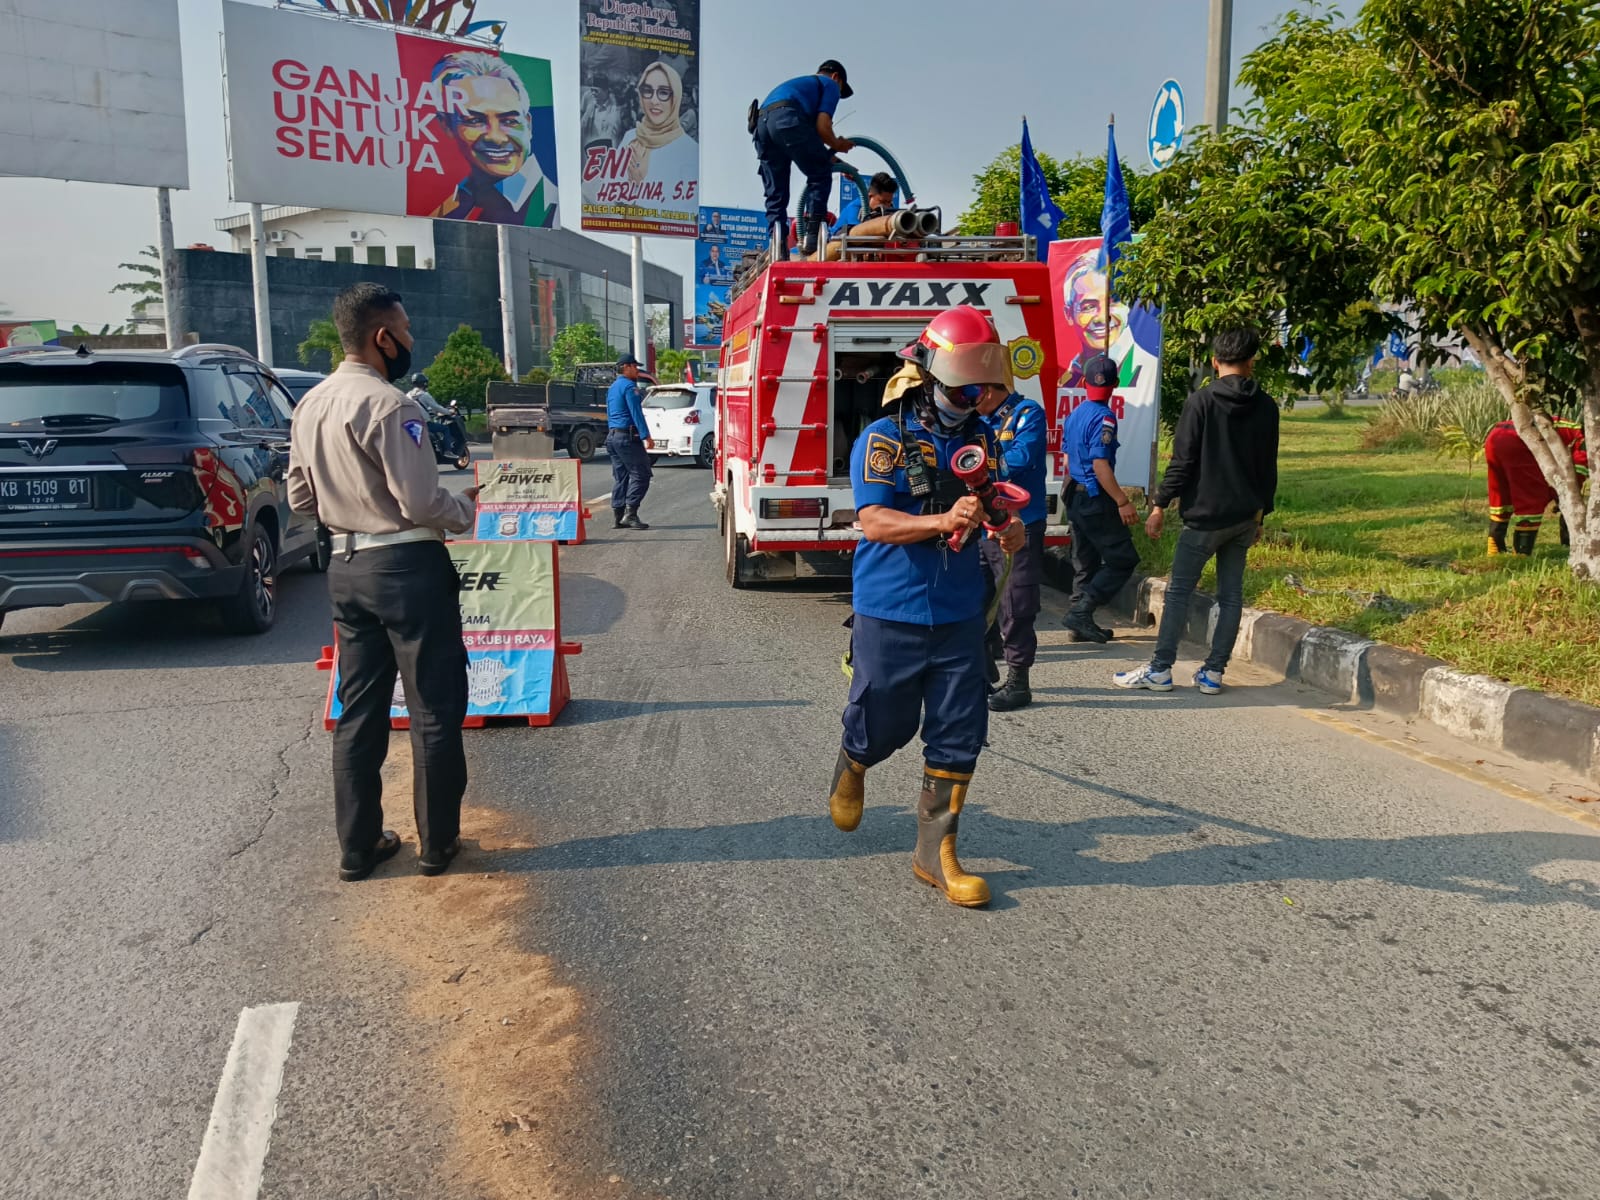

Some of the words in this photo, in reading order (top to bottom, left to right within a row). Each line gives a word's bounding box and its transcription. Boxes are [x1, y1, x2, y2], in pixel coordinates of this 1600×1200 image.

[603, 0, 677, 25] Dirgahayu
[586, 13, 640, 31] Republik
[641, 20, 692, 40] Indonesia
[272, 59, 470, 117] GANJAR
[273, 91, 439, 143] UNTUK
[275, 126, 445, 175] SEMUA
[582, 146, 632, 182] ENI
[596, 181, 666, 203] HERLINA,
[672, 180, 698, 201] S.E
[610, 206, 626, 216] DPR
[828, 282, 992, 306] AYAXX
[0, 482, 18, 497] KB
[25, 480, 58, 496] 1509
[498, 474, 554, 485] POWER
[477, 635, 511, 645] KUBU
[514, 634, 546, 644] RAYA
